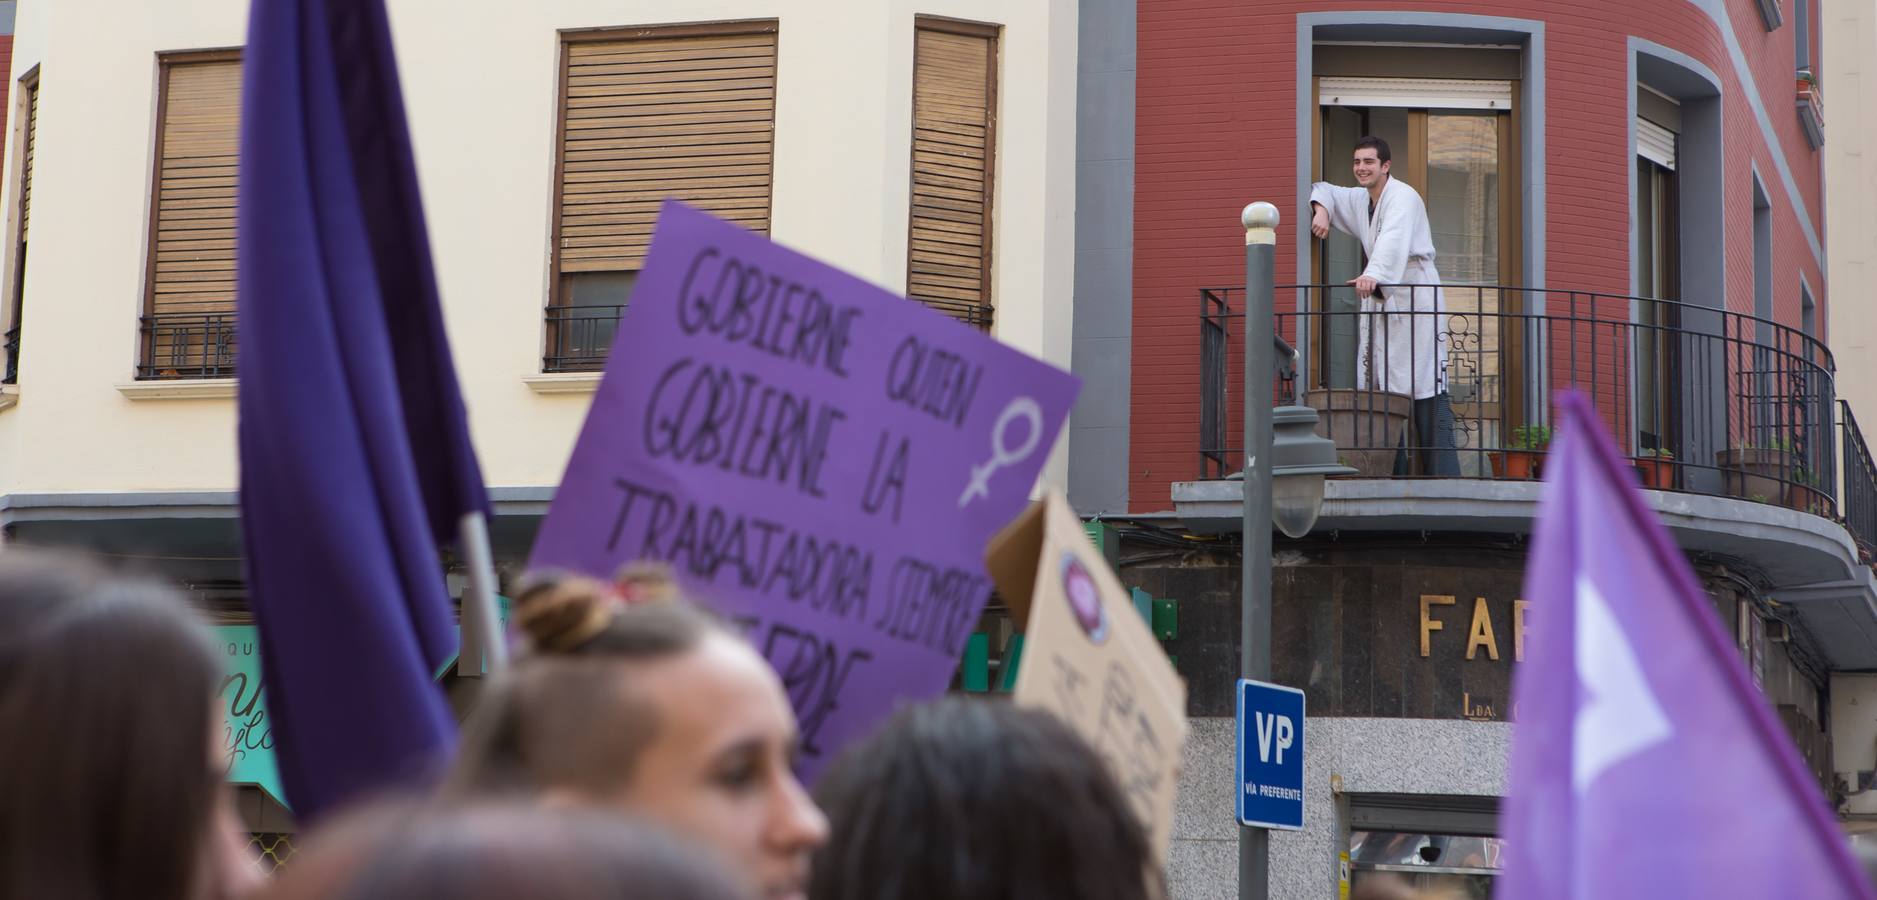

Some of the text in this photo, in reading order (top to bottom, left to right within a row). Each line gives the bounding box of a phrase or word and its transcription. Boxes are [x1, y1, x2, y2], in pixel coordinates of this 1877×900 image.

[677, 246, 985, 428] GOBIERNE QUIEN
[643, 356, 910, 524] GOBIERNE LA
[608, 478, 874, 621] TRABAJADORA
[1245, 781, 1302, 801] VÍA PREFERENTE
[1255, 711, 1294, 765] VP
